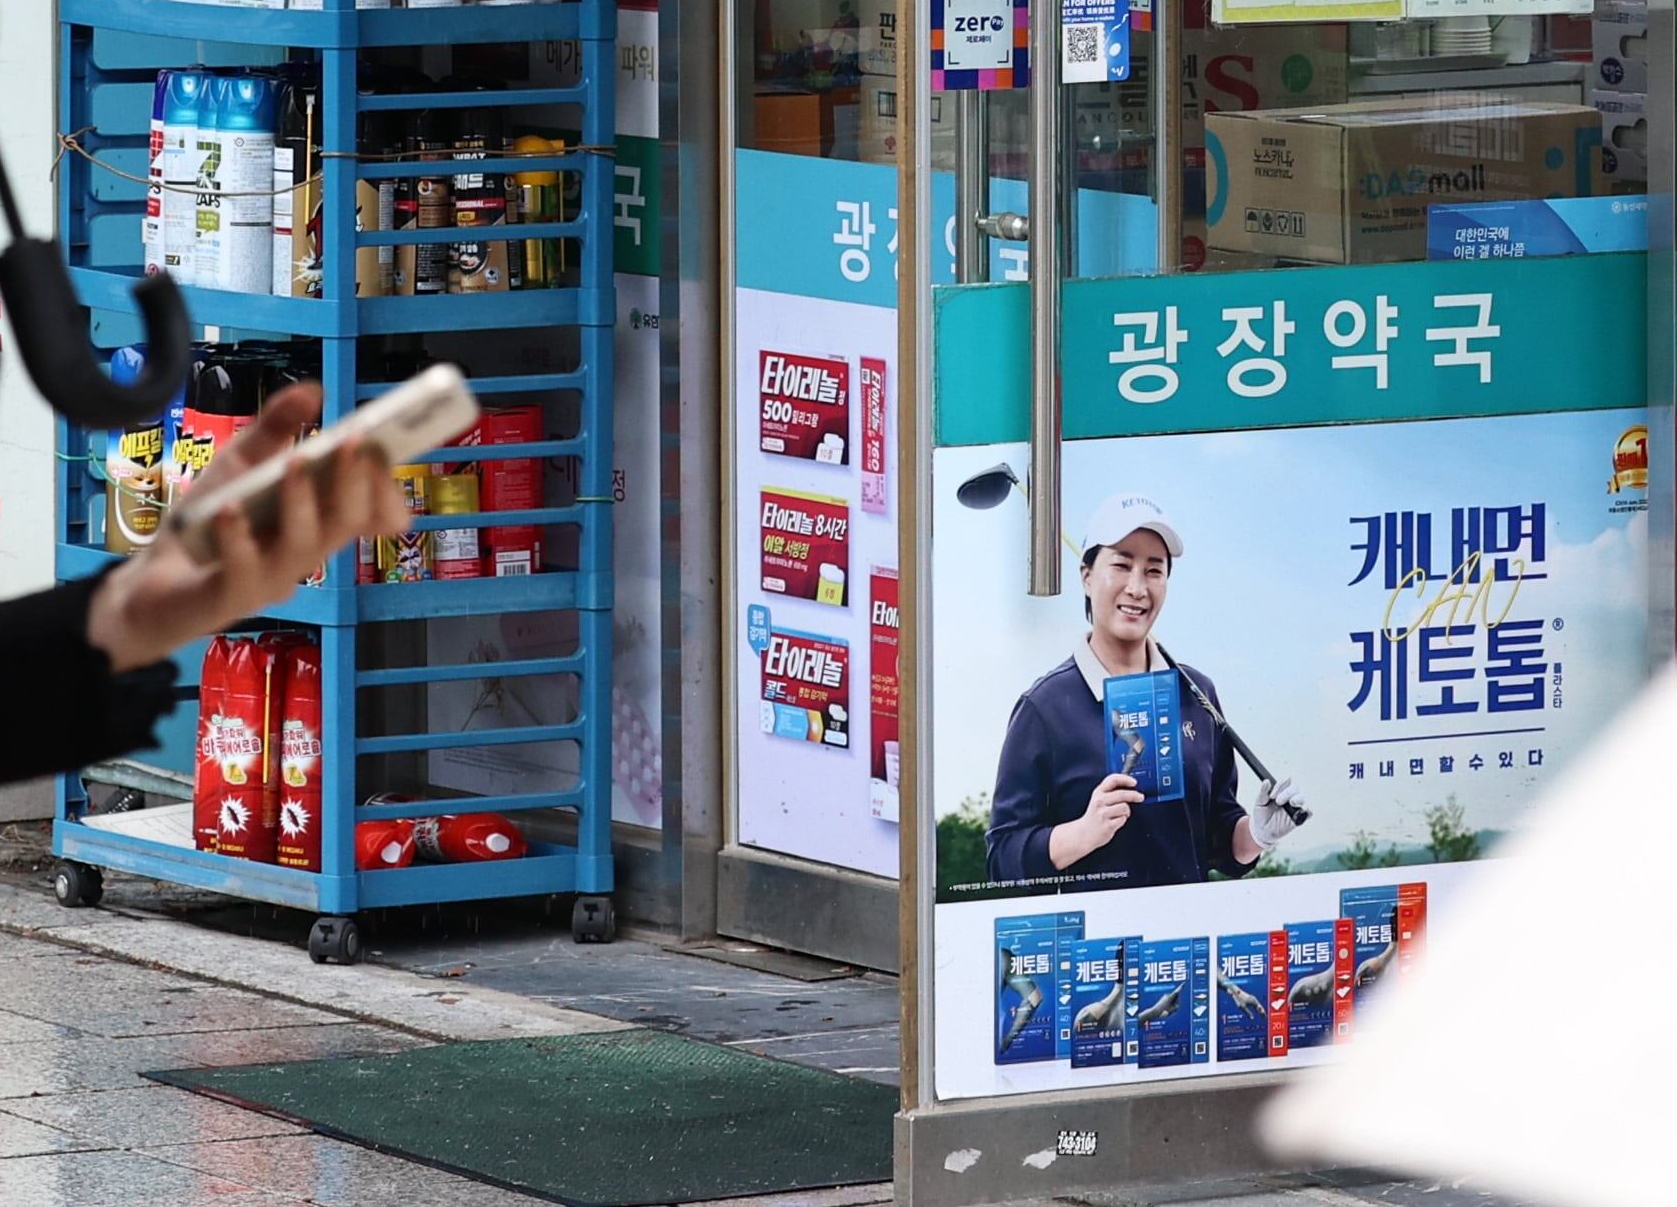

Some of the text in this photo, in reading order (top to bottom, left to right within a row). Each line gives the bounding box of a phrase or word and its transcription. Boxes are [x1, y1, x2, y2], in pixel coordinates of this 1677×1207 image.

[1455, 226, 1510, 242] 대한민국에
[1453, 244, 1474, 260] 이런
[1493, 242, 1525, 257] 하나쯤
[1109, 292, 1501, 403] 광장약국
[761, 355, 840, 404] 타이레놀
[762, 502, 814, 536] 타이레놀
[1347, 502, 1548, 590] 캐내면
[1383, 550, 1525, 646] CAN
[765, 636, 843, 689] 타이레놀
[1347, 619, 1549, 722] 케토톱
[764, 679, 787, 700] 콜드
[1553, 662, 1562, 710] 플라스타
[1118, 711, 1149, 730] 케토톱
[1355, 924, 1393, 945] 케토톱
[1010, 954, 1050, 975] 케토톱
[1221, 954, 1264, 978] 케토톱
[1288, 941, 1331, 966] 케토톱
[1076, 959, 1120, 983] 케토톱
[1144, 959, 1187, 984] 케토톱
